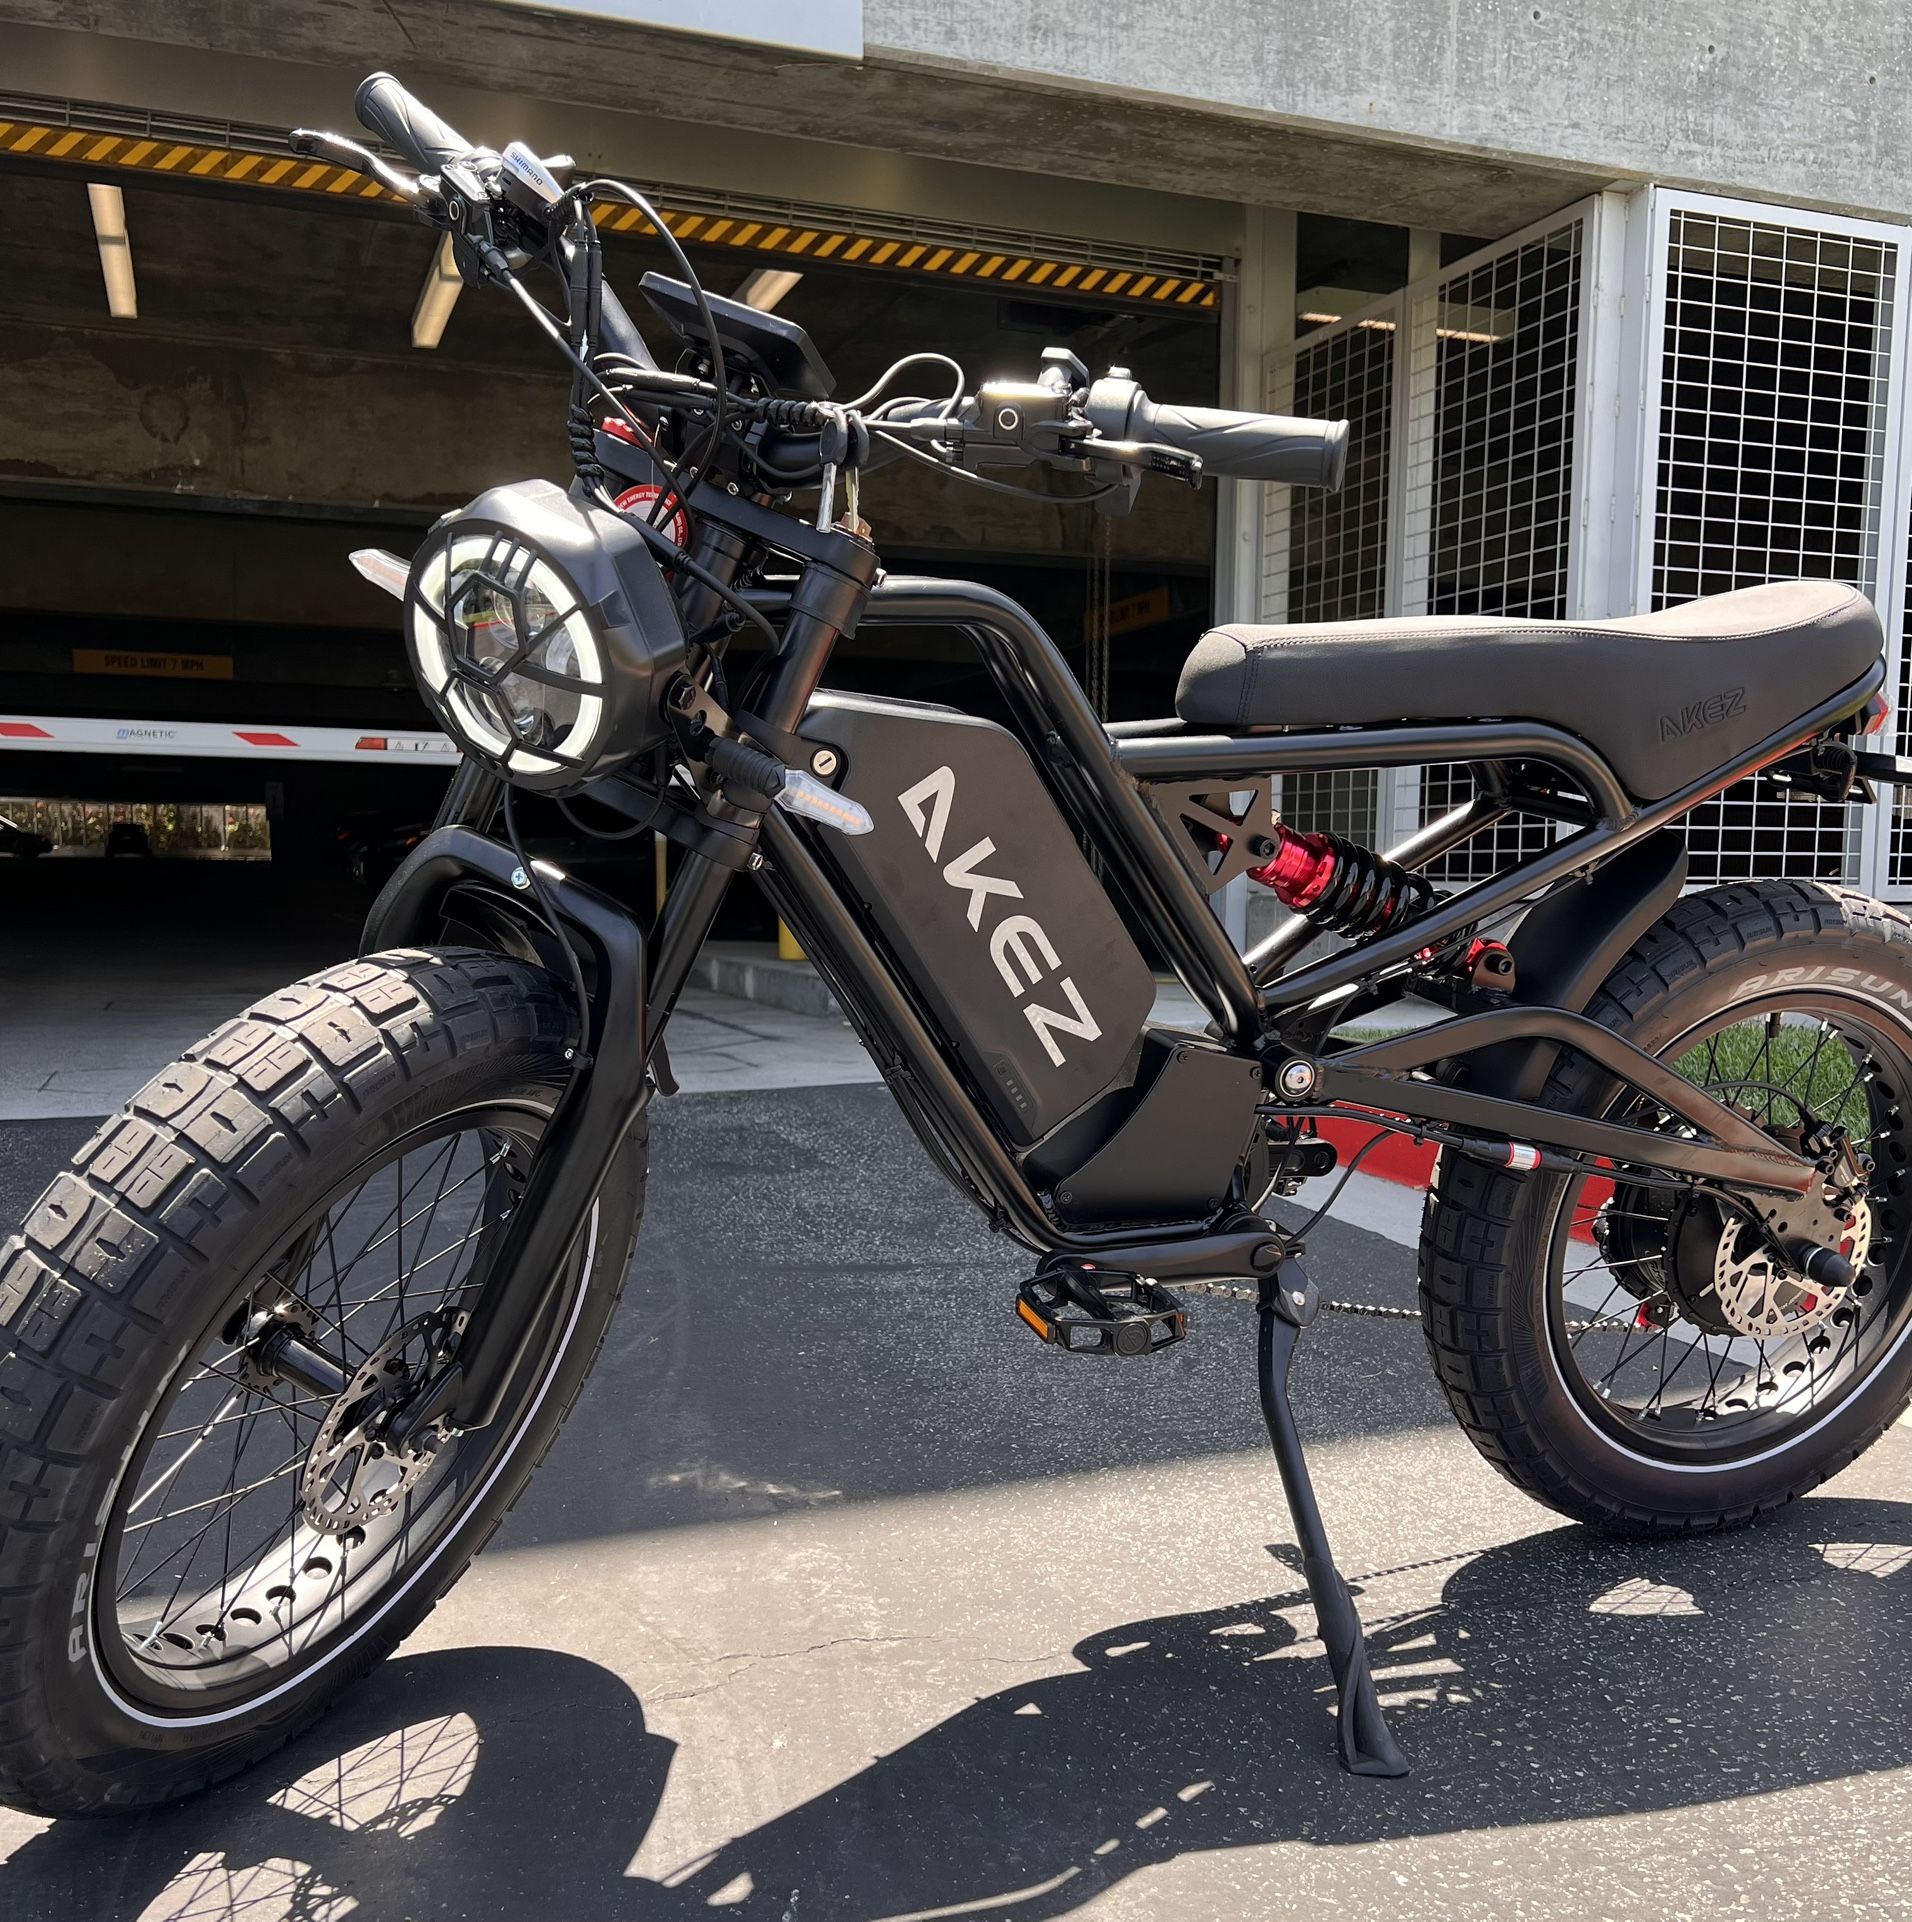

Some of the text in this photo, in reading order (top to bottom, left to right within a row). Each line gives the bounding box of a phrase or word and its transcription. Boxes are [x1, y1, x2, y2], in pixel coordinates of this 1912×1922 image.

[510, 151, 544, 186] SHIMANO
[104, 654, 137, 669] SPEED
[140, 655, 167, 670] LIMIT
[180, 658, 205, 672] MPH
[1660, 687, 1746, 742] AKEZ
[898, 766, 1103, 1067] AKEZ
[1727, 965, 1912, 1010] ARISUN
